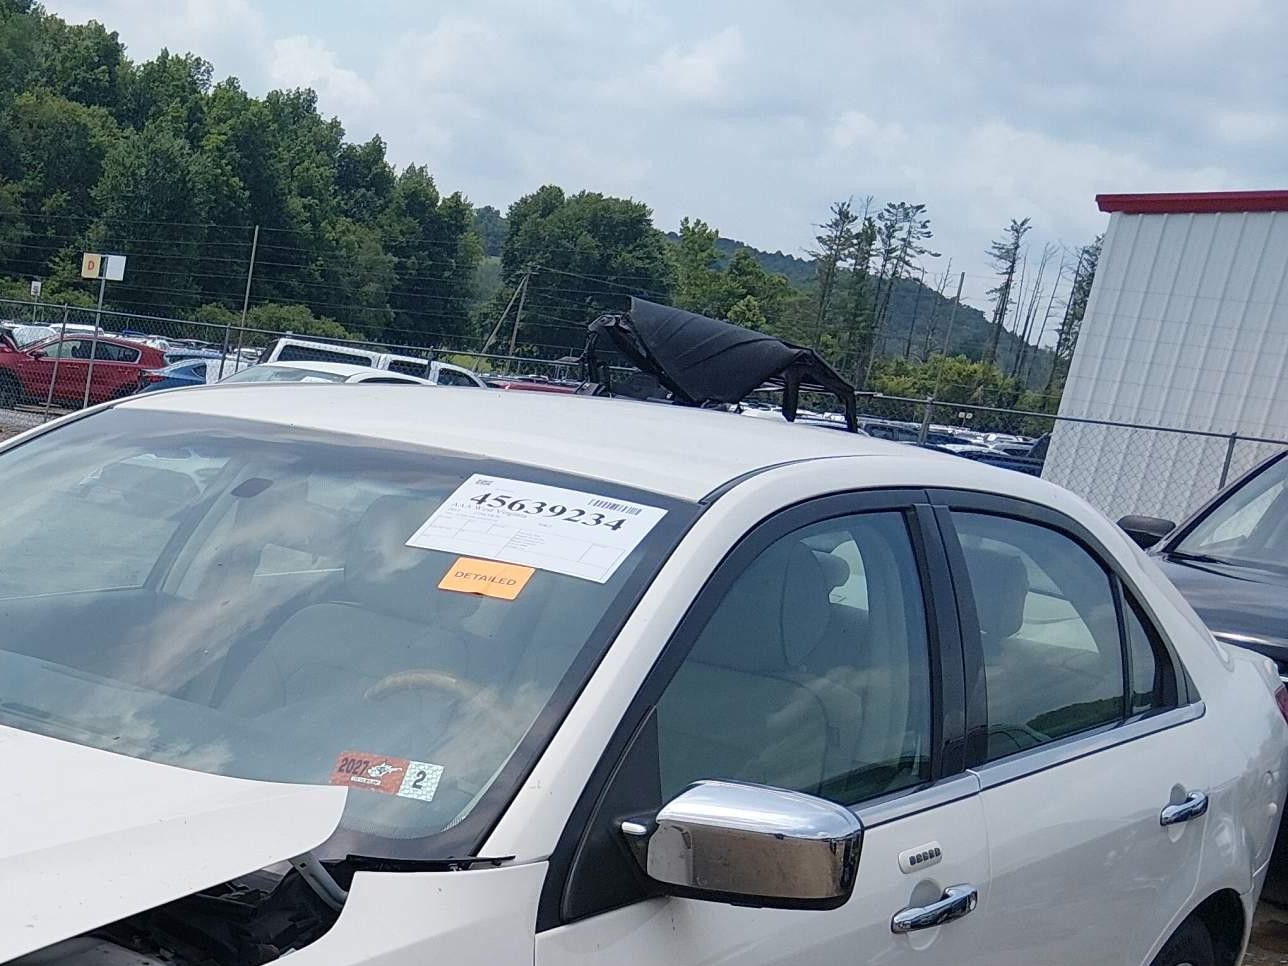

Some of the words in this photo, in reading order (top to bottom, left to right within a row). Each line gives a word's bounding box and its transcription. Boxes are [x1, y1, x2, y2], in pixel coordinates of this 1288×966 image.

[87, 260, 95, 270] D
[470, 493, 627, 531] 45639234
[454, 571, 517, 586] DETAILED
[339, 757, 369, 776] 2027
[412, 770, 427, 789] 2
